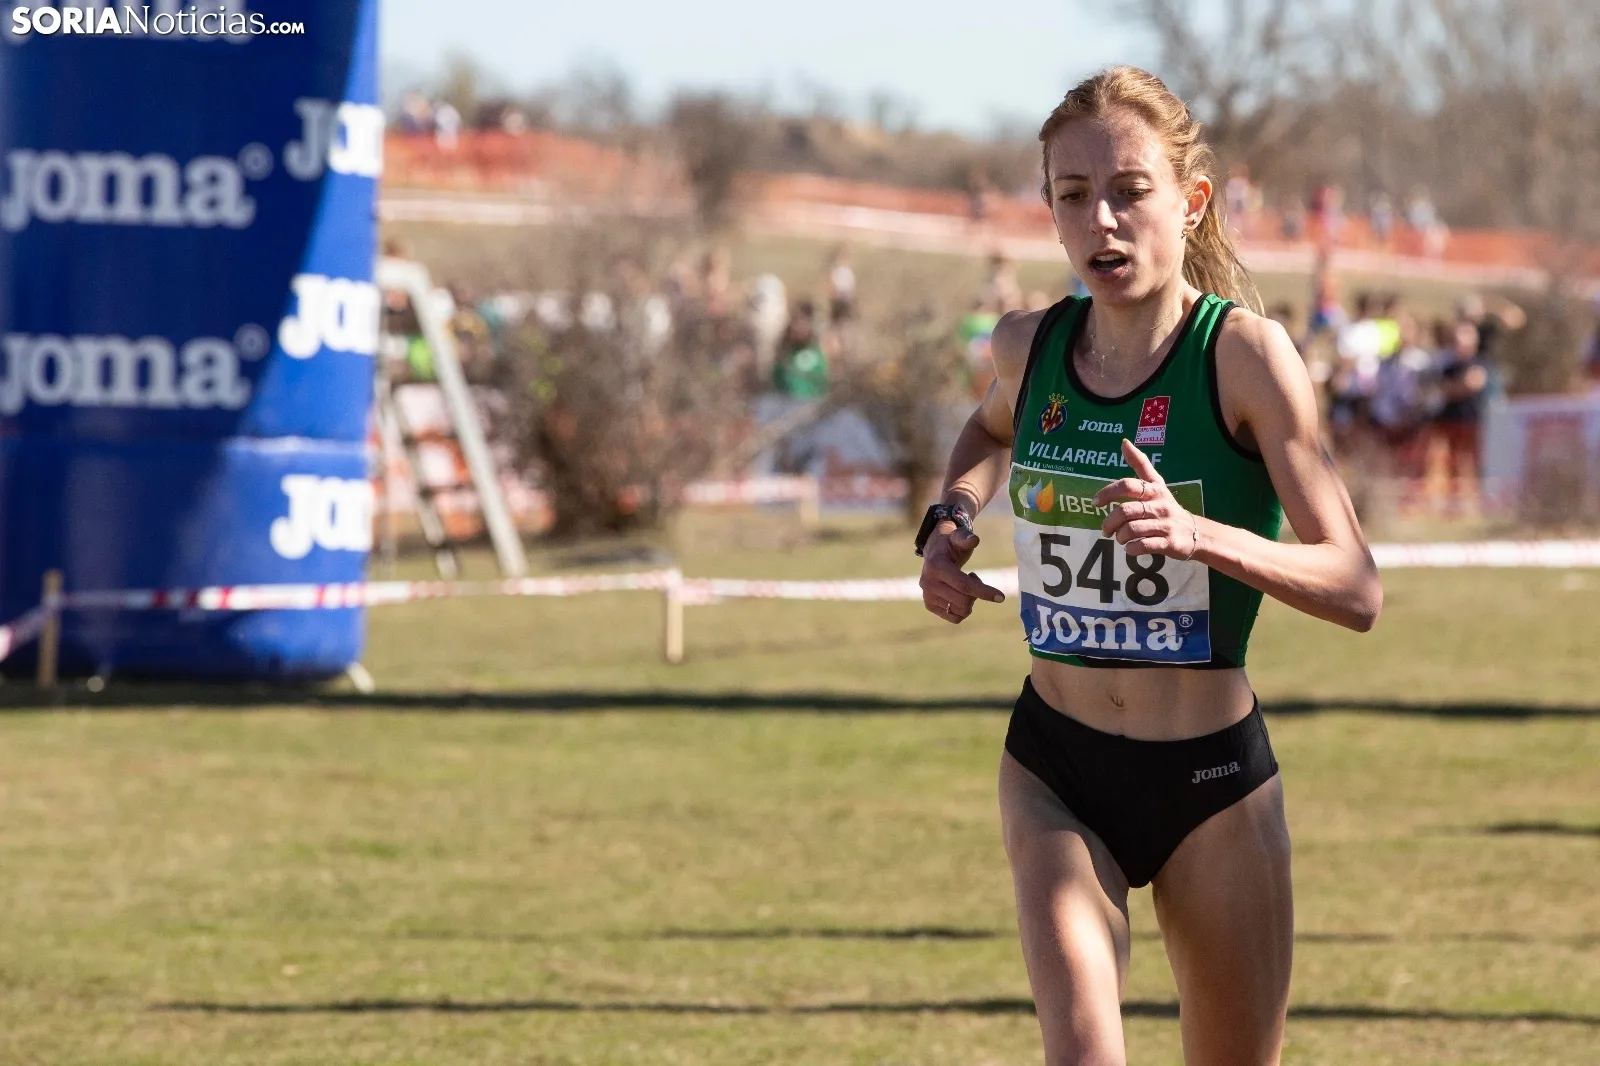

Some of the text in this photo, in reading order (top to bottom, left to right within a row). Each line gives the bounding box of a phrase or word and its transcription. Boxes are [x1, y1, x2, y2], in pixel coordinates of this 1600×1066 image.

[283, 97, 384, 180] Jo
[1078, 419, 1123, 434] Joma
[1028, 441, 1129, 468] VILLARREAL
[270, 475, 374, 559] Jo
[1039, 532, 1170, 606] 548
[1191, 761, 1240, 784] Joma
